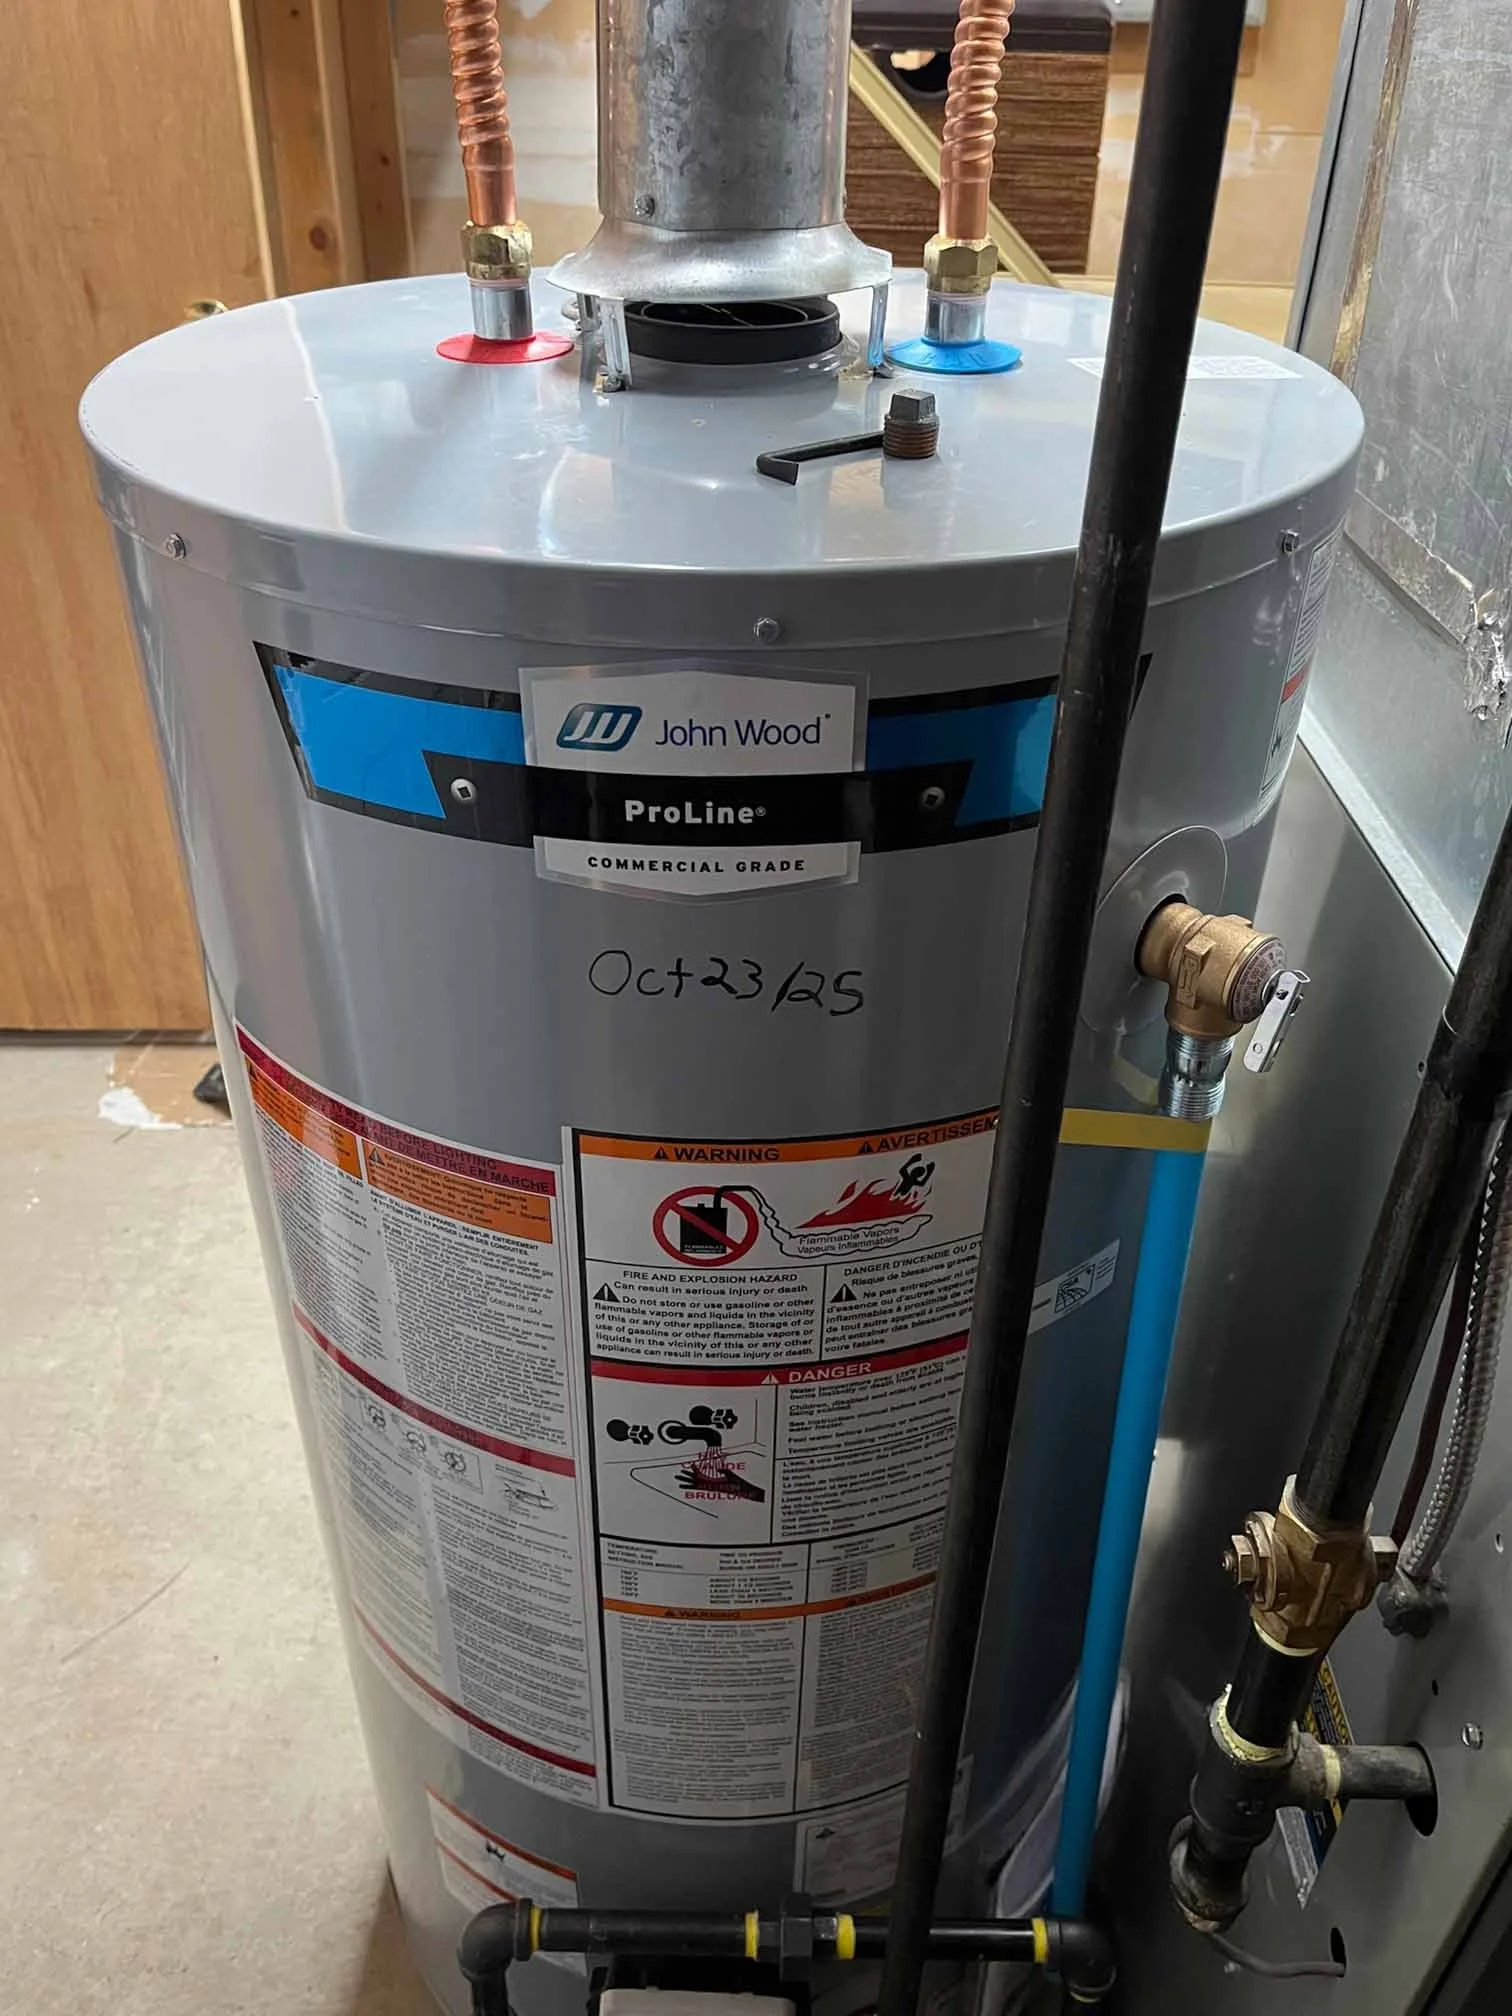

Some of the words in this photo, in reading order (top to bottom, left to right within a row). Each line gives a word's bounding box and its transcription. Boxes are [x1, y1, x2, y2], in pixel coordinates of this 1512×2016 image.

[655, 718, 726, 747] John
[735, 716, 821, 745] Wood
[588, 857, 724, 873] COMMERCIAL
[736, 860, 805, 873] GRADE
[674, 1147, 779, 1161] WARNING
[490, 1172, 549, 1192] MARCHE
[800, 1231, 860, 1245] Flammable
[863, 1227, 899, 1239] Vapors
[798, 1245, 835, 1254] Vapeurs
[844, 1262, 890, 1276] DANGER
[893, 1249, 950, 1268] D'INCENDIE
[952, 1245, 968, 1255] OU
[624, 1271, 648, 1280] FIRE
[651, 1273, 676, 1281] AND
[680, 1275, 746, 1283] EXPLOSION
[750, 1274, 798, 1283] HAZARD
[851, 1275, 885, 1286] Risque
[887, 1271, 899, 1280] de
[614, 1281, 634, 1290] Can
[638, 1285, 669, 1293] result
[729, 1288, 760, 1297] injury
[778, 1285, 808, 1294] death
[879, 1288, 897, 1298] pas
[622, 1296, 637, 1304] Do
[660, 1300, 686, 1308] store
[725, 1301, 770, 1311] gasoline
[787, 1299, 814, 1307] other
[880, 1298, 893, 1306] ou
[594, 1302, 647, 1315] flammable
[649, 1310, 684, 1318] vapors
[687, 1311, 706, 1319] and
[710, 1311, 744, 1321] liquids
[778, 1308, 815, 1318] vicinity
[595, 1313, 605, 1321] of
[608, 1315, 626, 1323] this
[642, 1320, 661, 1329] any
[663, 1321, 690, 1329] other
[748, 1321, 788, 1330] Storage
[615, 1325, 626, 1333] of
[628, 1328, 669, 1338] gasoline
[685, 1331, 711, 1339] other
[713, 1331, 764, 1339] flammable
[767, 1330, 801, 1339] vapors
[595, 1332, 632, 1343] liquids
[635, 1337, 644, 1345] in
[648, 1338, 664, 1346] the
[667, 1340, 707, 1350] vicinity
[710, 1341, 721, 1349] of
[724, 1341, 744, 1349] this
[762, 1341, 781, 1350] any
[784, 1338, 814, 1347] other
[664, 1350, 691, 1358] result
[705, 1351, 741, 1360] serious
[743, 1351, 770, 1361] injury
[789, 1362, 872, 1383] DANGER
